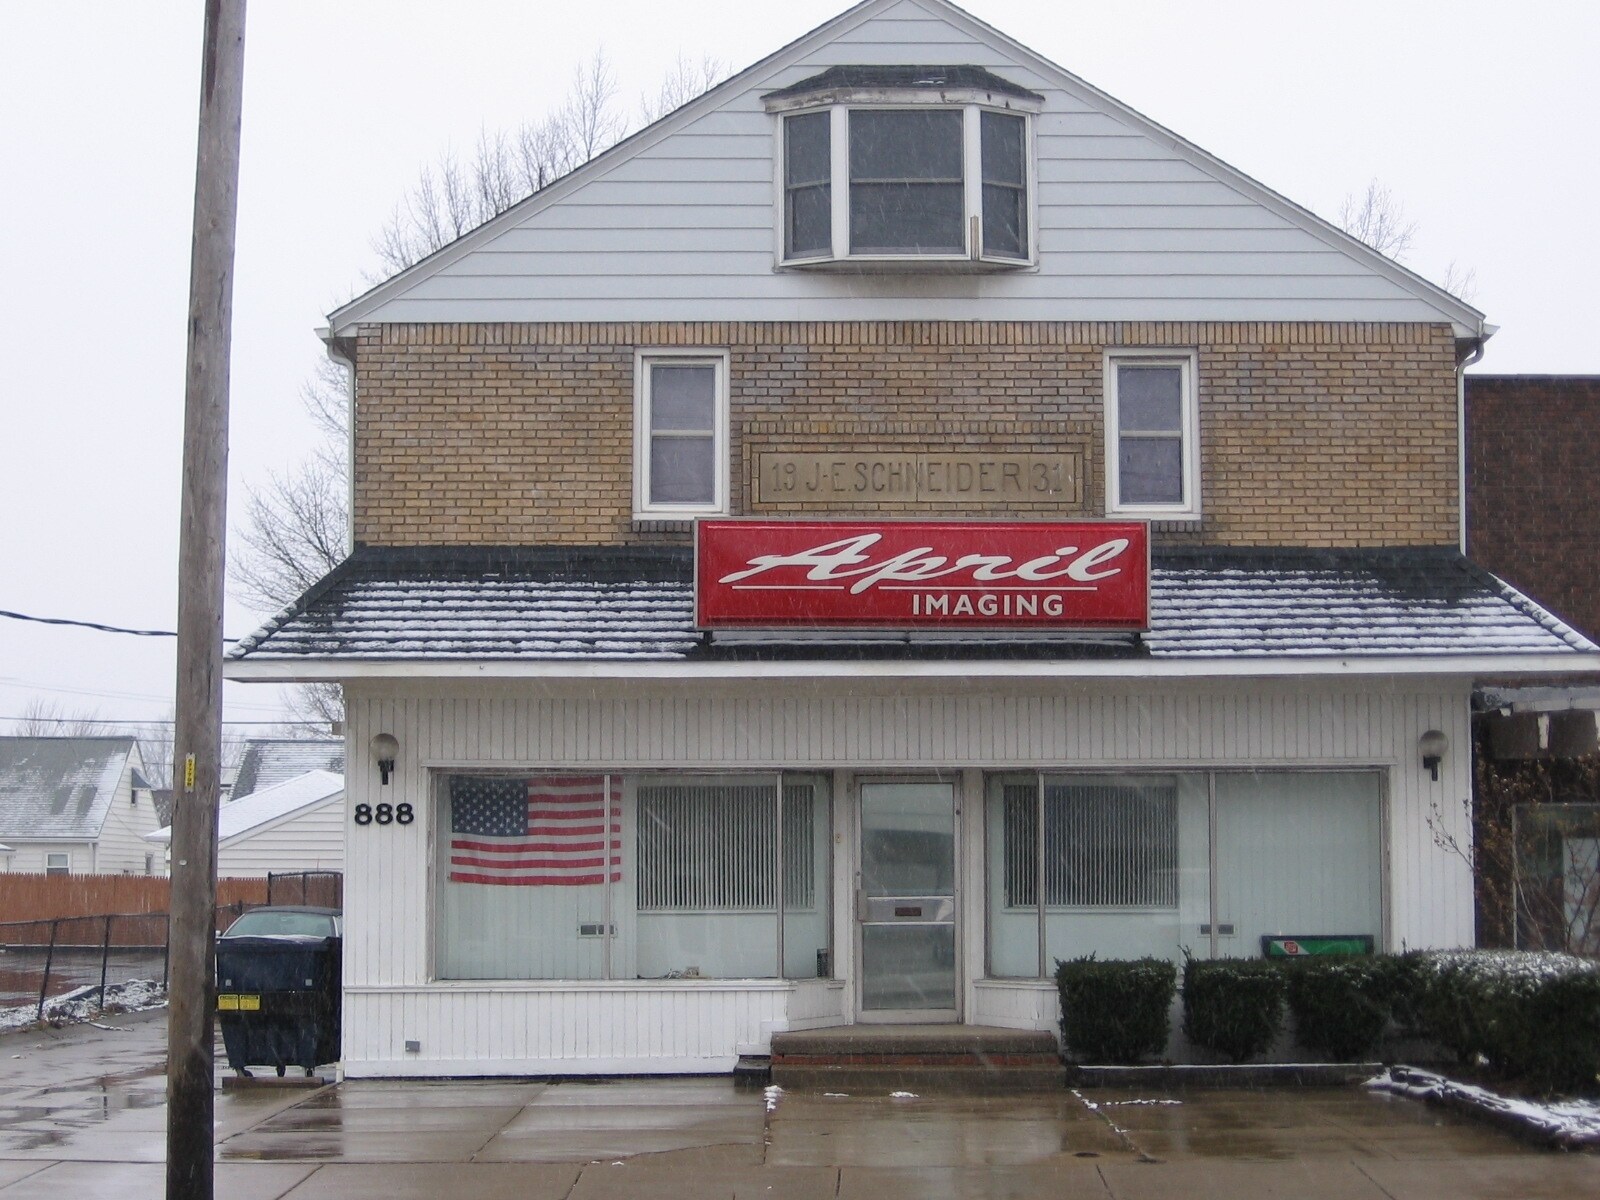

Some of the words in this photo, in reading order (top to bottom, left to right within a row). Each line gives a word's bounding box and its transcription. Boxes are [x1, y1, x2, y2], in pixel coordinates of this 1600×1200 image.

[773, 462, 797, 492] 19
[1032, 462, 1062, 492] 31
[718, 533, 1129, 594] April
[913, 594, 1064, 616] IMAGING
[354, 803, 414, 825] 888
